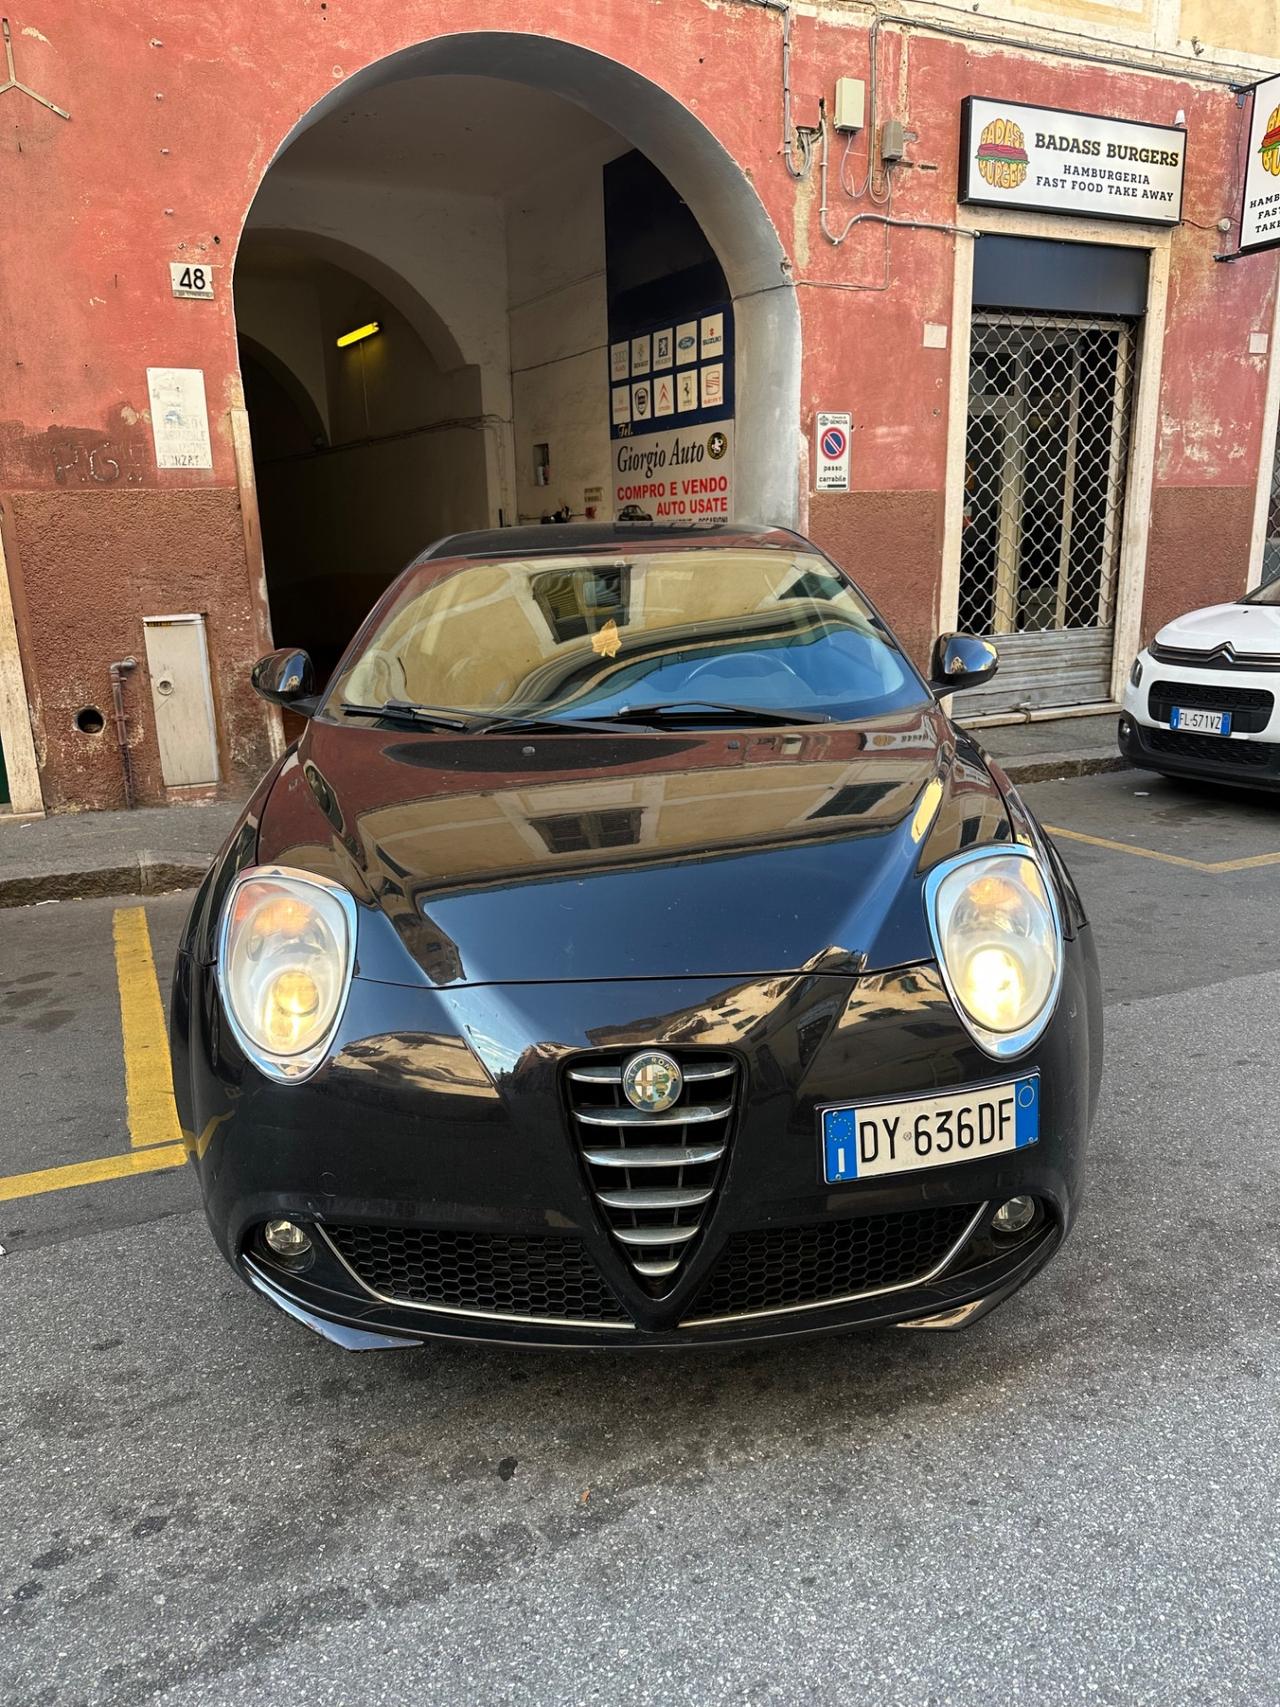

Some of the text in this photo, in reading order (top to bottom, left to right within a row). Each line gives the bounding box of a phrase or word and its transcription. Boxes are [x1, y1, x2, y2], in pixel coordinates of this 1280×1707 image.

[1035, 132, 1179, 168] BADASS BURGERS
[1063, 164, 1150, 185] HAMBURGERIA
[1036, 175, 1174, 202] FAST FOOD TAKE AWAY
[180, 267, 206, 290] 48
[617, 436, 705, 479] Giorgio Auto
[616, 482, 665, 501] COMPRO
[669, 481, 678, 497] E
[682, 475, 728, 496] VENDO
[818, 475, 846, 483] carrabile
[656, 496, 728, 516] AUTO USATE
[859, 1097, 1014, 1163] DY 636DF
